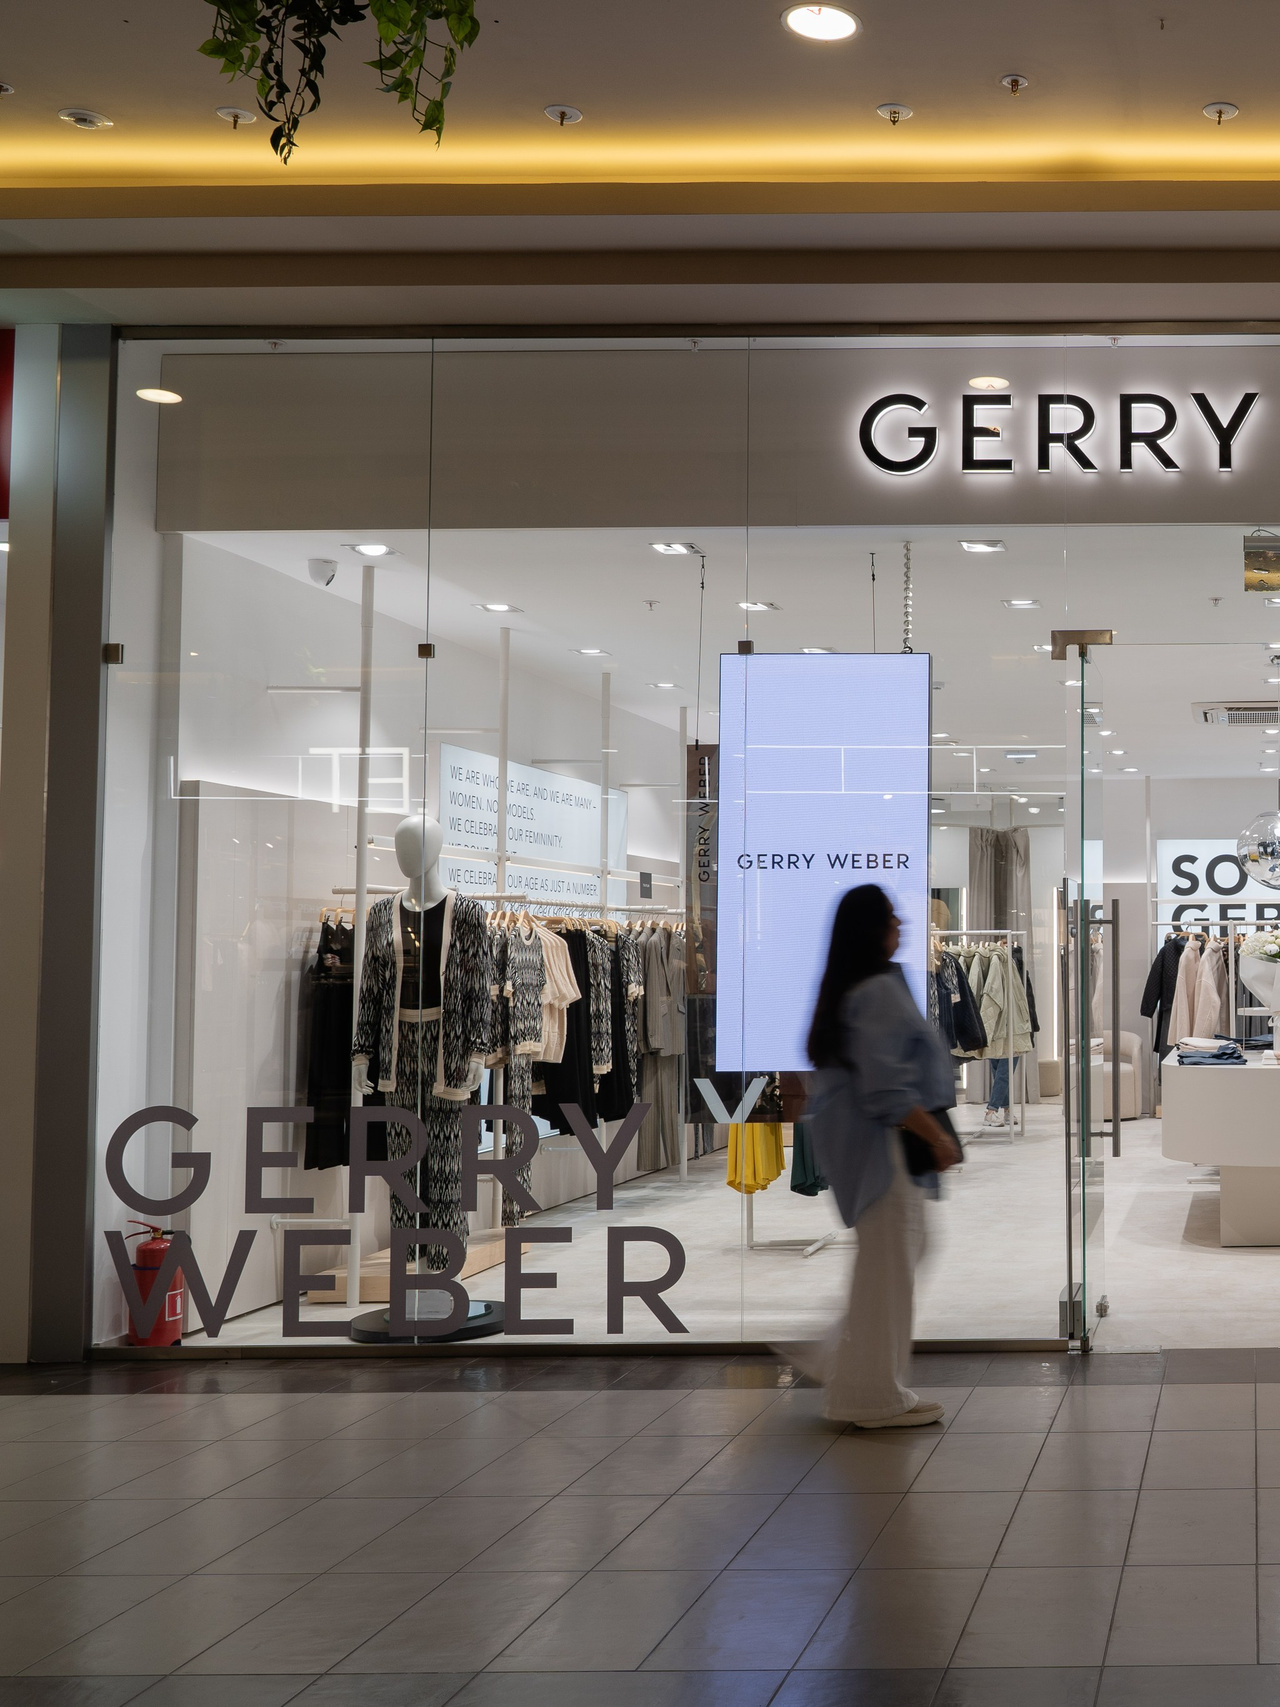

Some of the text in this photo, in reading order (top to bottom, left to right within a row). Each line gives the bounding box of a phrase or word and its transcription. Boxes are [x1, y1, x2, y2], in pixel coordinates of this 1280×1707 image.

[859, 392, 1260, 475] GERRY
[449, 790, 484, 811] WOMEN.
[506, 803, 536, 821] MODELS.
[450, 765, 462, 781] WE
[465, 770, 480, 785] ARE
[516, 782, 531, 797] ARE.
[533, 786, 548, 801] AND
[550, 789, 560, 804] WE
[561, 793, 573, 806] ARE
[574, 795, 592, 810] MANY
[449, 816, 462, 832] WE
[464, 819, 498, 837] CELEBRA
[508, 826, 523, 841] OUR
[525, 830, 563, 849] FEMININITY.
[698, 756, 711, 882] GERRY WEBER
[448, 867, 461, 883] WE
[464, 870, 497, 886] CELEBRA
[507, 874, 522, 889] OUR
[524, 877, 538, 891] AGE
[540, 878, 548, 892] AS
[550, 880, 565, 893] JUST
[573, 882, 598, 897] NUMBER.
[737, 853, 910, 870] GERRY WEBER
[1171, 854, 1248, 897] SO
[105, 1101, 652, 1217] GERRY
[104, 1226, 691, 1339] WEBER
